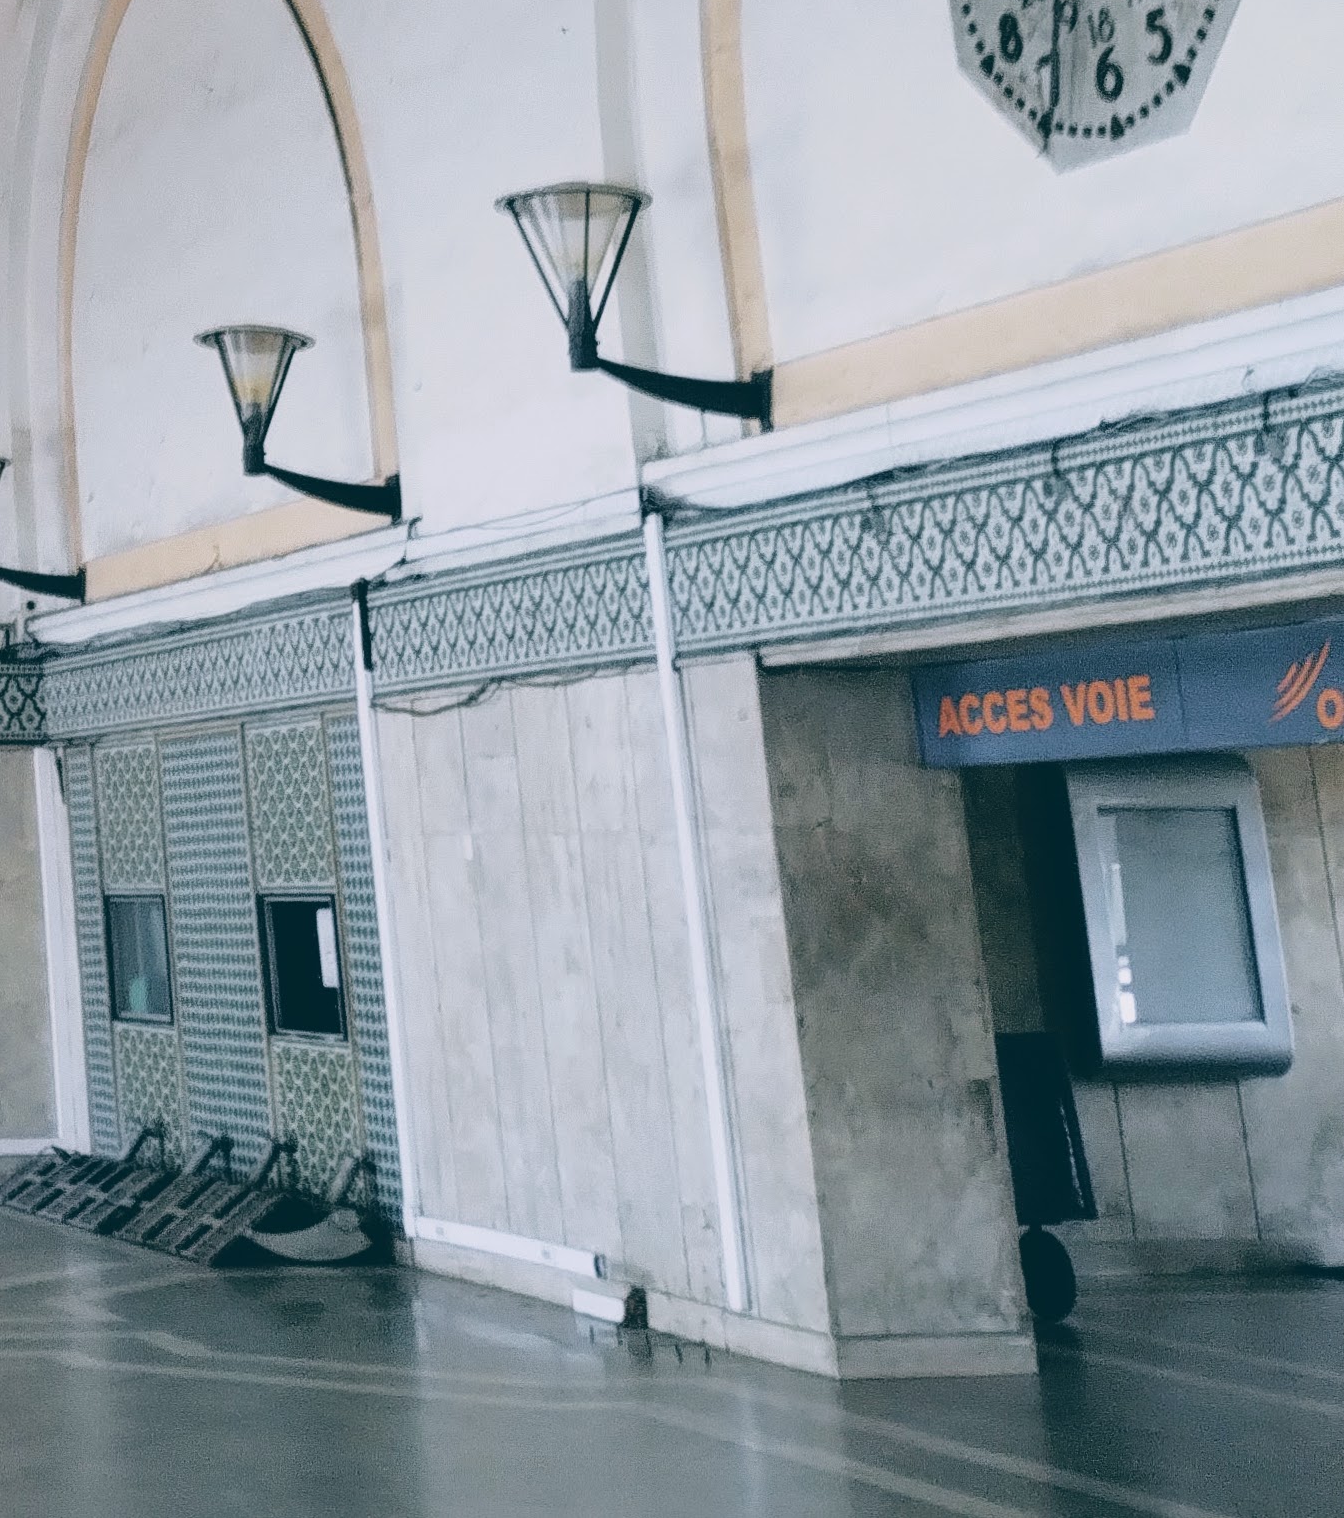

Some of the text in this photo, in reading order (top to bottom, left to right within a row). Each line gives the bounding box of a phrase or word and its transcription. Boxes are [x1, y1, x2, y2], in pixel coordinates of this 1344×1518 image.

[999, 11, 1023, 65] 8
[1146, 6, 1173, 65] 5
[1095, 45, 1125, 104] 6
[938, 673, 1156, 739] ACCES VOIE
